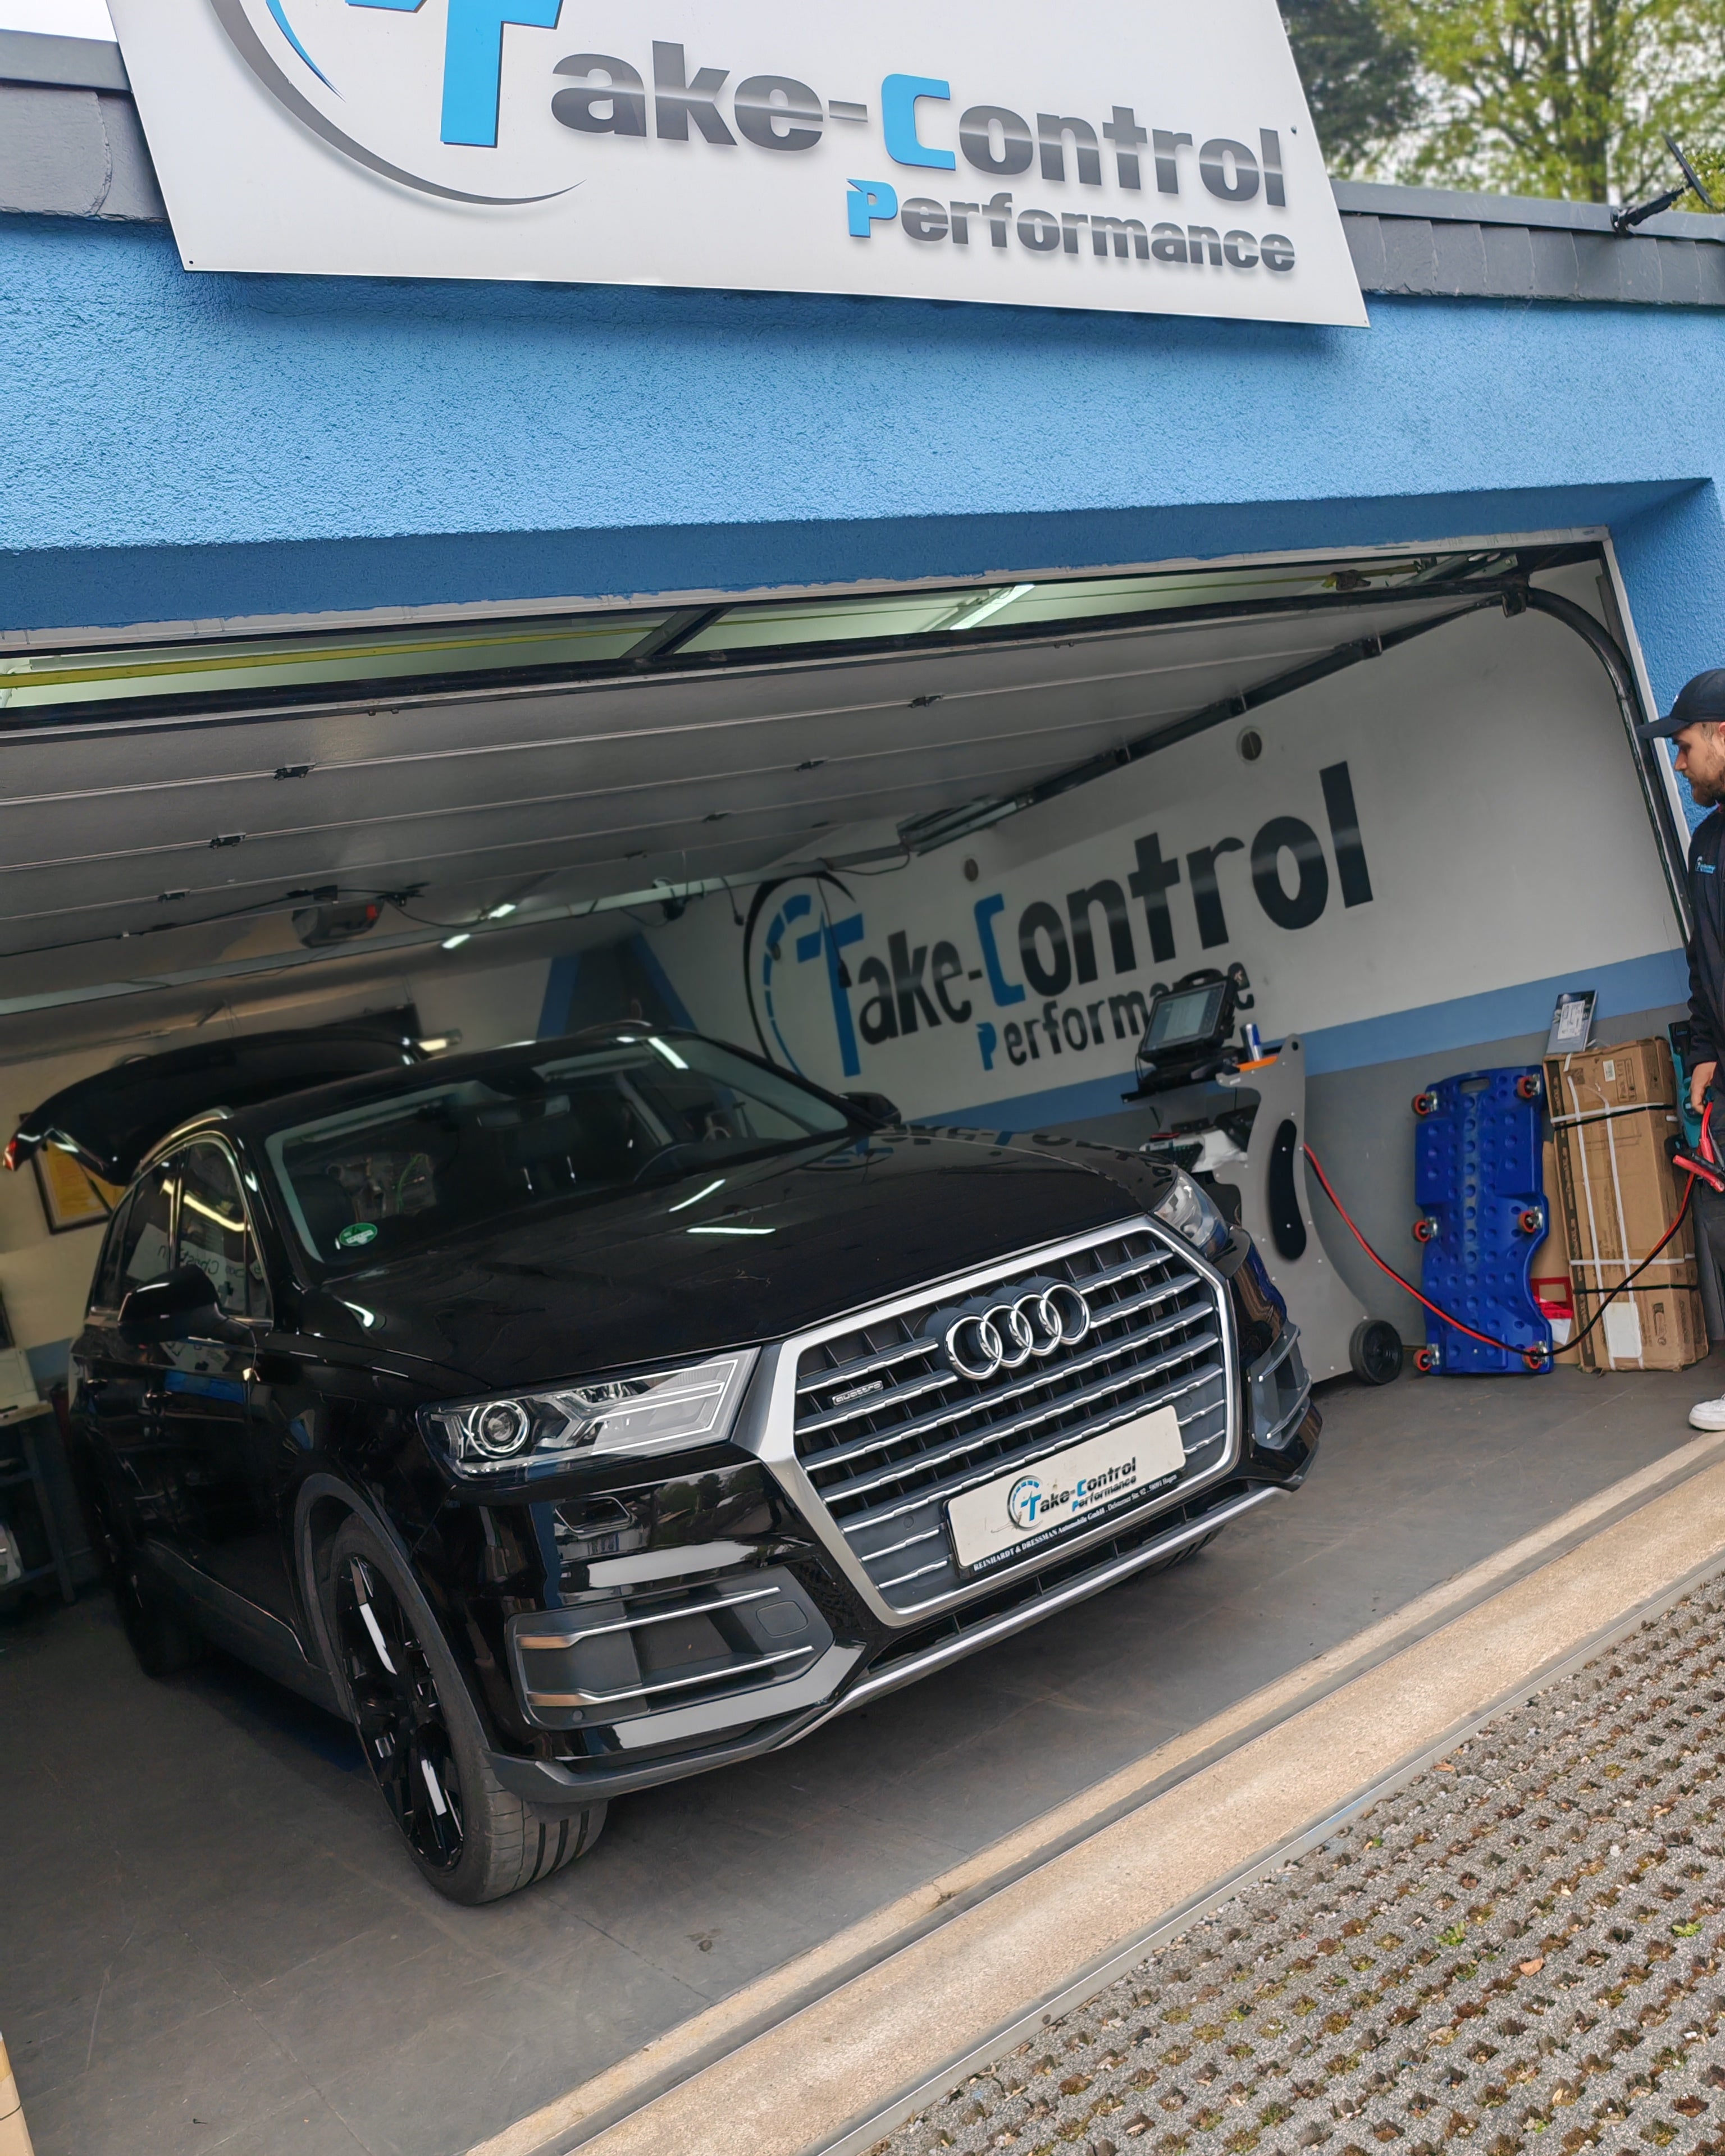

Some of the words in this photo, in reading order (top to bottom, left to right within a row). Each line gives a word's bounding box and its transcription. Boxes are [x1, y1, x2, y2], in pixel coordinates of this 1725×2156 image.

[345, 0, 1286, 208] Take-Control
[848, 177, 1297, 272] Performance
[796, 760, 1374, 1078] Take-Control
[976, 961, 1256, 1071] Performe
[835, 1382, 882, 1403] quattro
[1020, 1456, 1137, 1522] Take-Control
[1072, 1475, 1137, 1512] Performance
[973, 1547, 1015, 1572] REINHARDT
[1015, 1545, 1022, 1554] &
[1021, 1529, 1058, 1550] DRESSMAN
